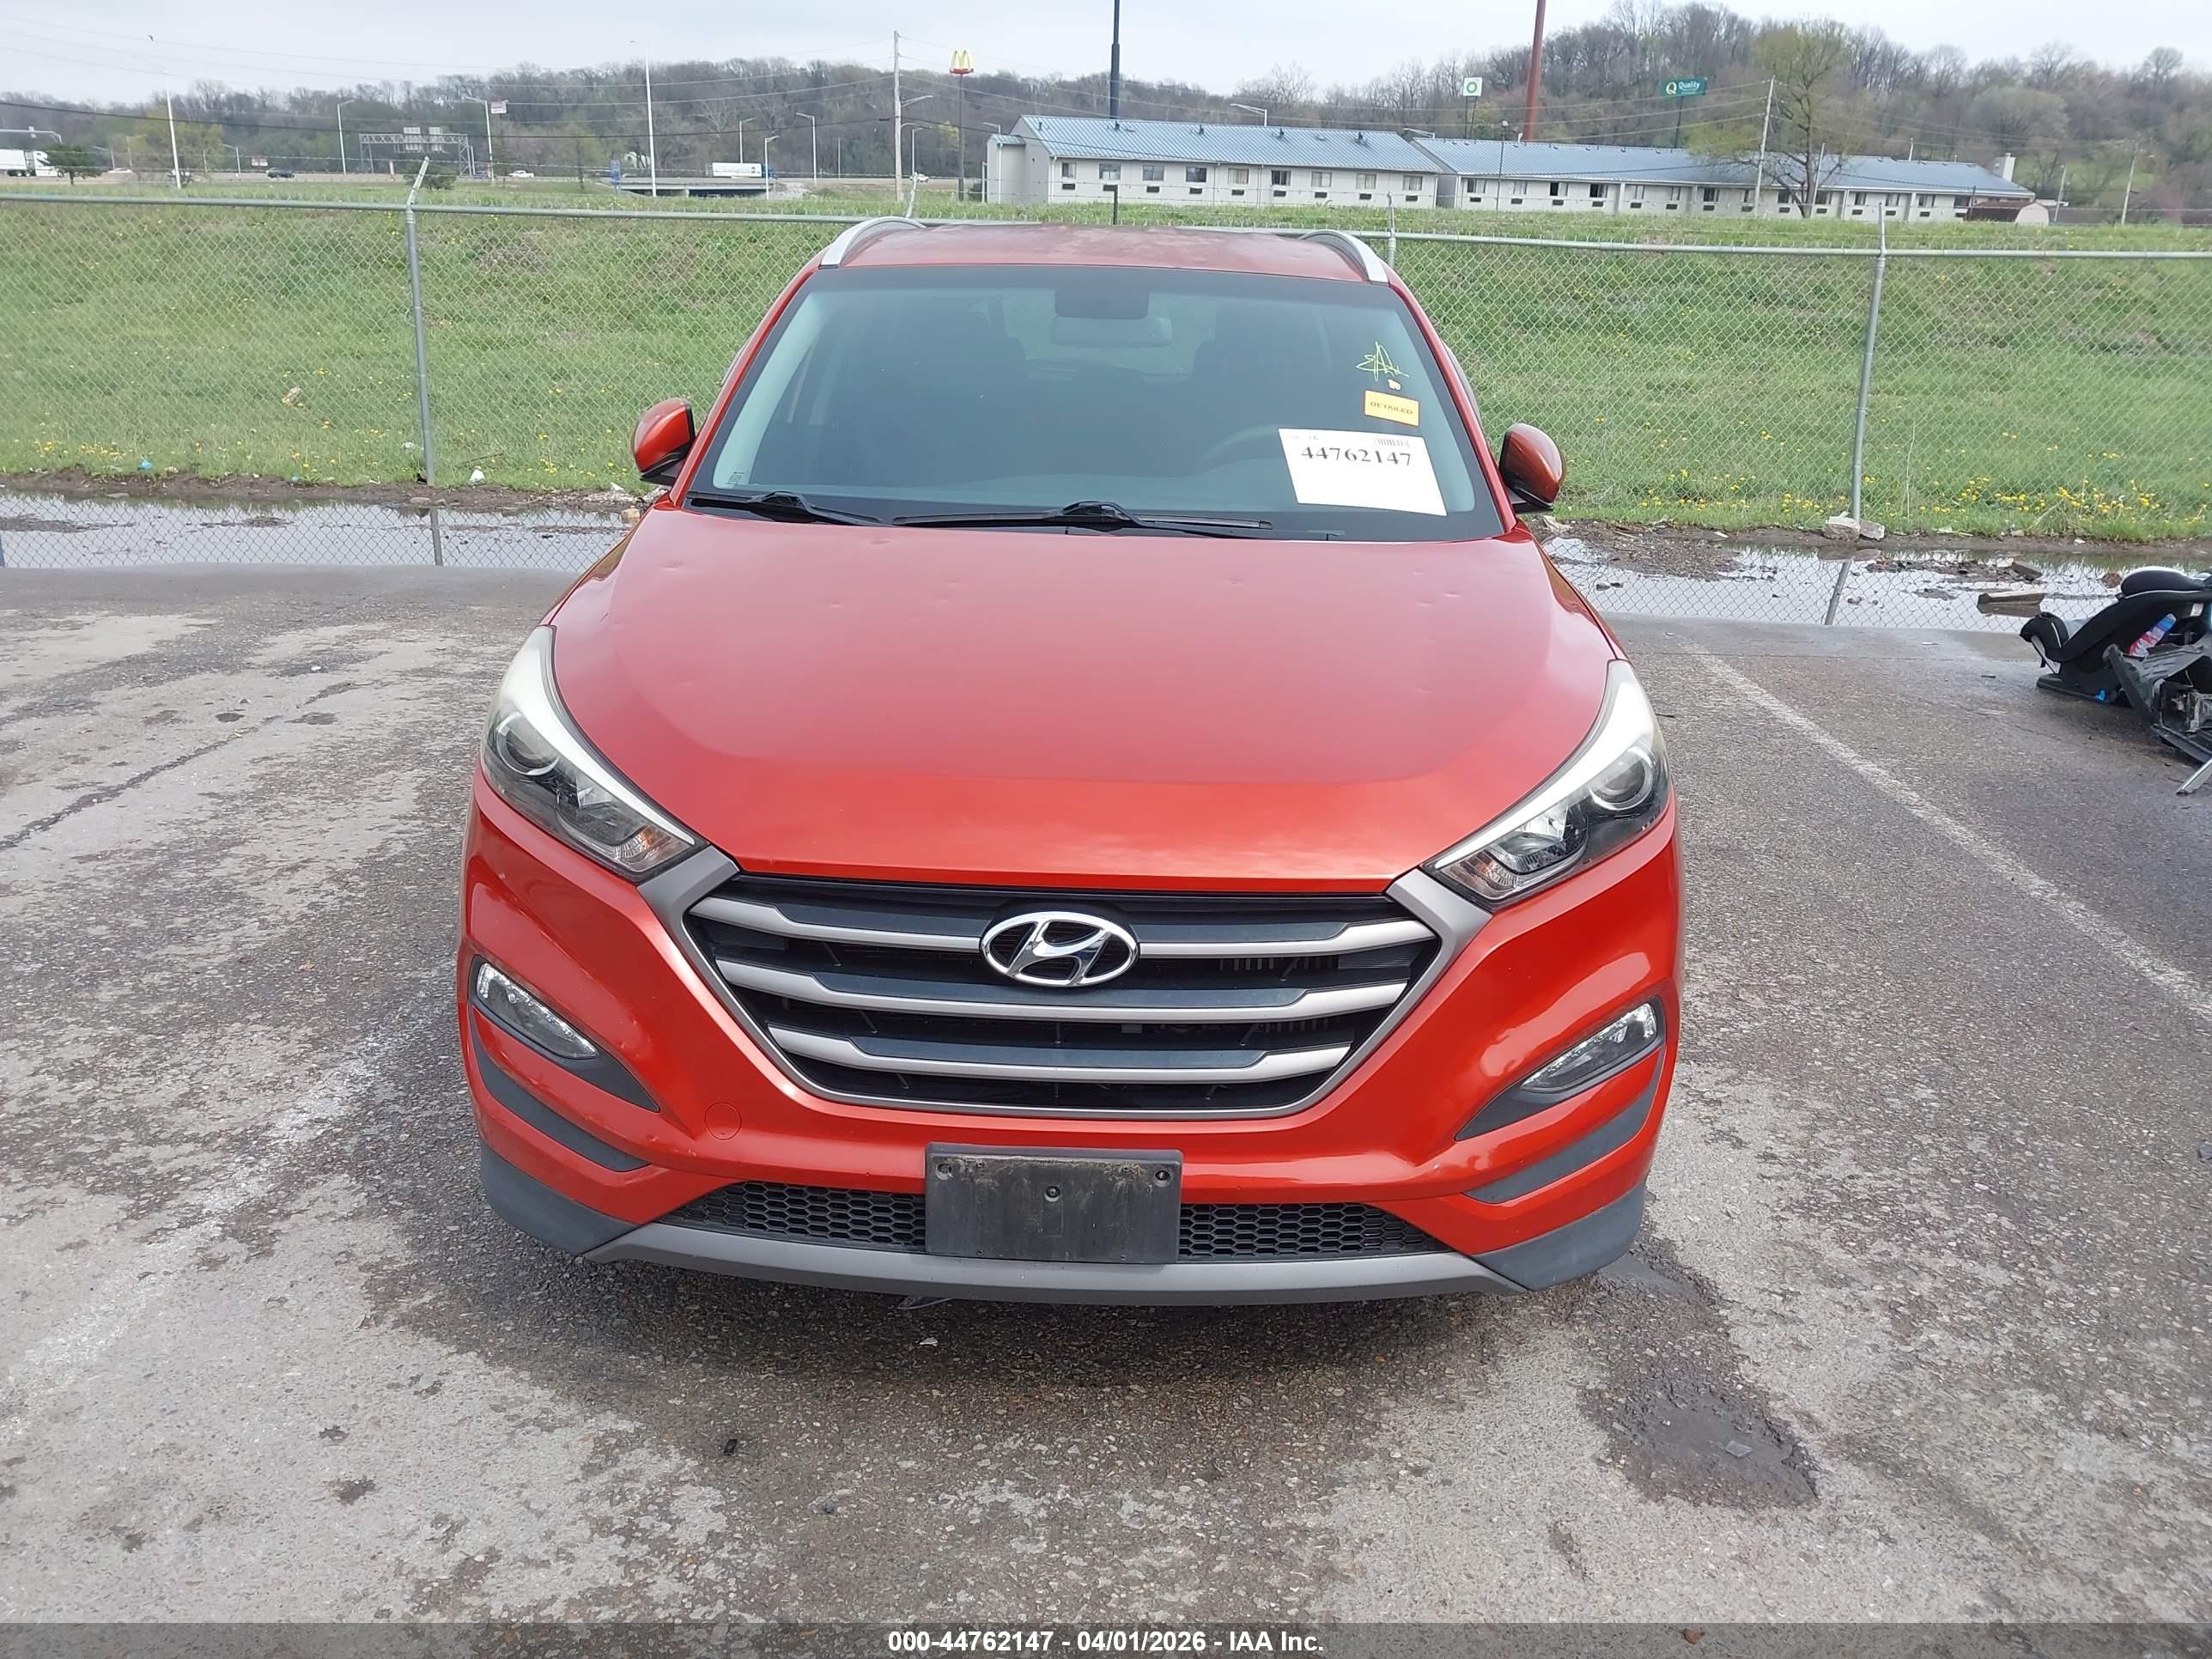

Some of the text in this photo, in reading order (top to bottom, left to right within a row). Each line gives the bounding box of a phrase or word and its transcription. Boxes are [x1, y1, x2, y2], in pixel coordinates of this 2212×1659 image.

[1678, 81, 1700, 91] Quality
[1370, 400, 1413, 416] DETAILED
[1301, 446, 1411, 466] 44762147
